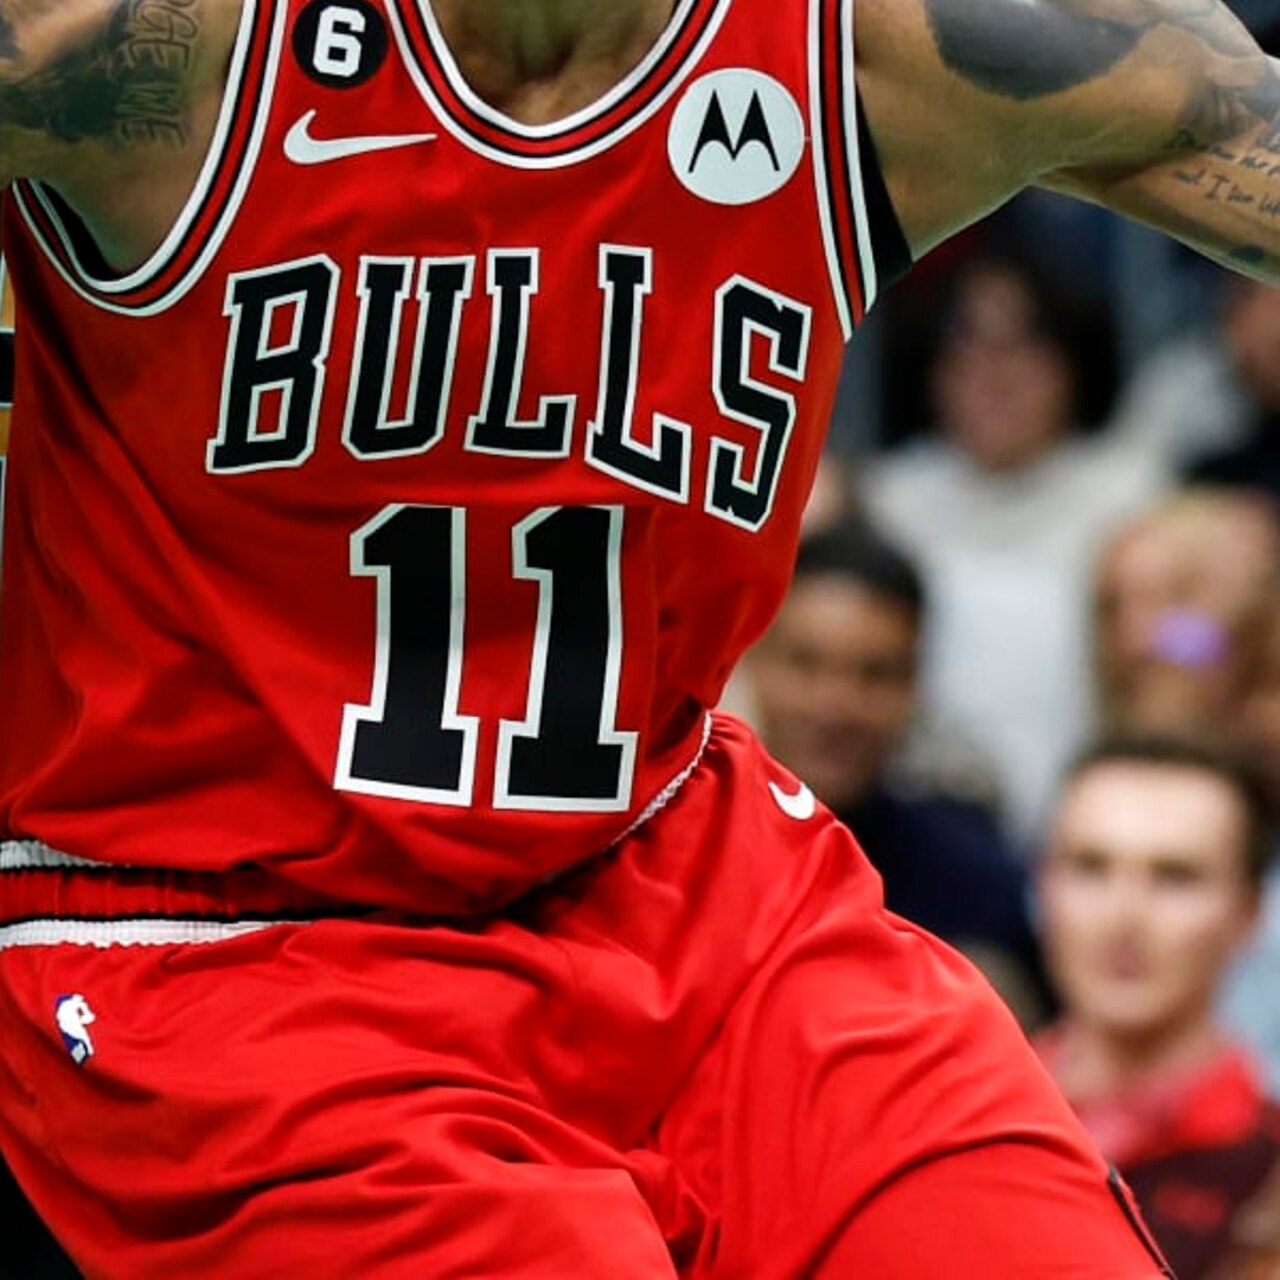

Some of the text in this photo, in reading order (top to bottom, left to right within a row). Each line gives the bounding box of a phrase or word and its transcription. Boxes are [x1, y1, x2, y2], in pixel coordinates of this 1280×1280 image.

[312, 5, 368, 79] 6
[205, 242, 812, 532] BULLS
[333, 503, 638, 812] 11
